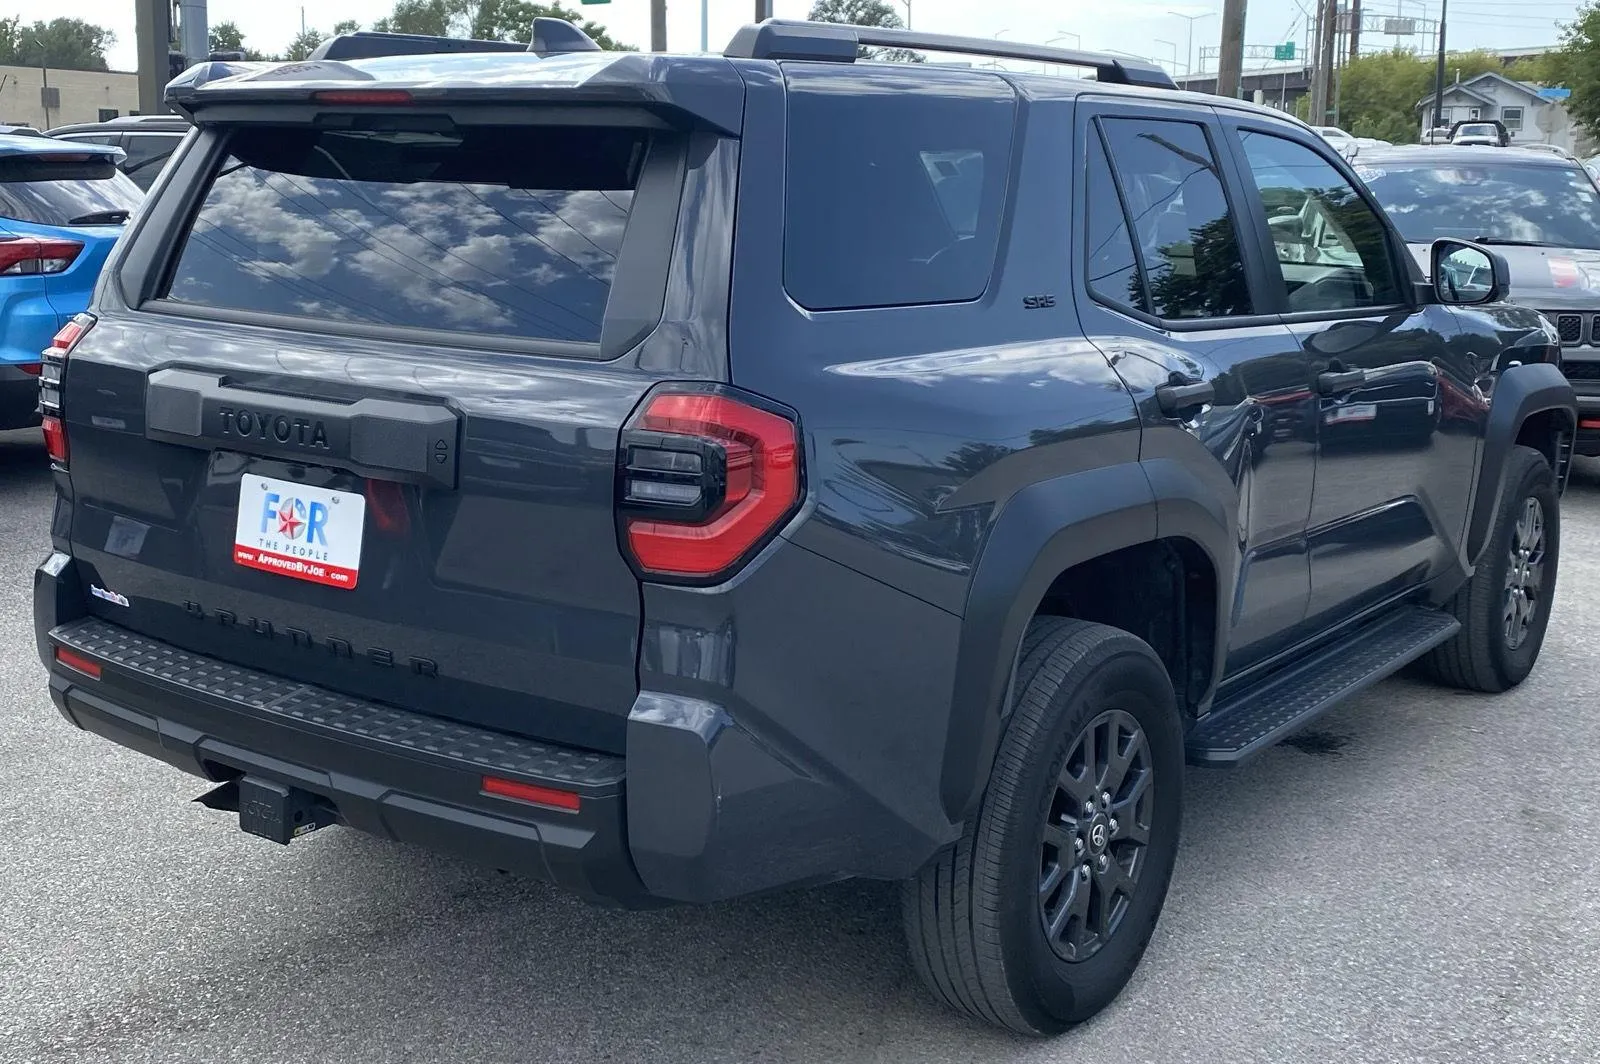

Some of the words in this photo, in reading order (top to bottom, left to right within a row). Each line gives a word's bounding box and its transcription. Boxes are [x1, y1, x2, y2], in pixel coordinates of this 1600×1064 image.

[1023, 294, 1057, 310] SR5
[219, 406, 330, 450] TOYOTA
[260, 492, 329, 546] FOR
[259, 538, 279, 551] THE
[285, 545, 329, 561] PEOPLE
